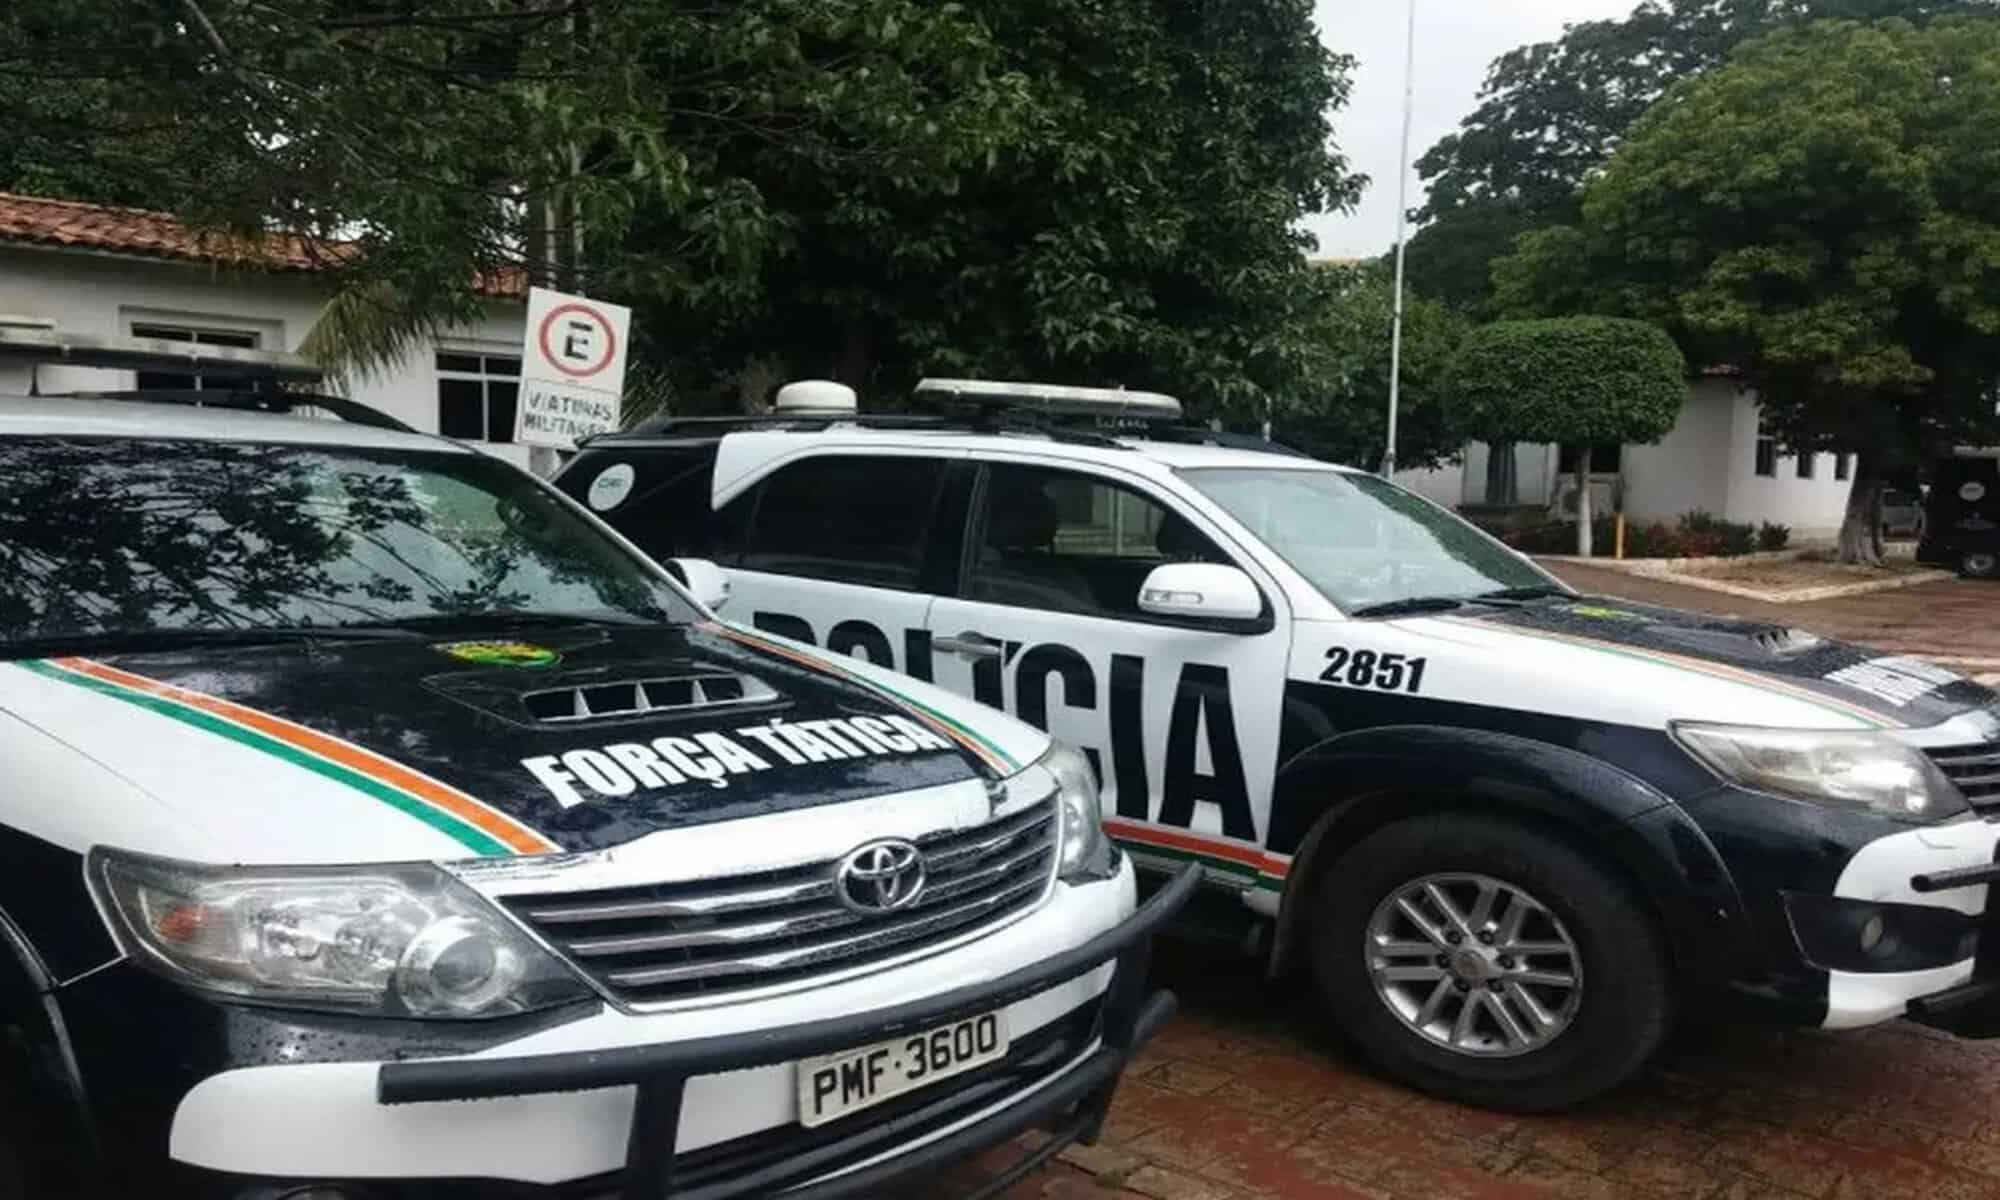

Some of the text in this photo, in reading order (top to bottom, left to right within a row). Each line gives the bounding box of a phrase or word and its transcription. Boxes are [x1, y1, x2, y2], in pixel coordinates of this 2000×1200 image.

[564, 320, 593, 360] E
[528, 391, 612, 421] VIATURAS
[1319, 646, 1427, 693] 2851
[520, 714, 954, 808] FORÇA TÁTICA
